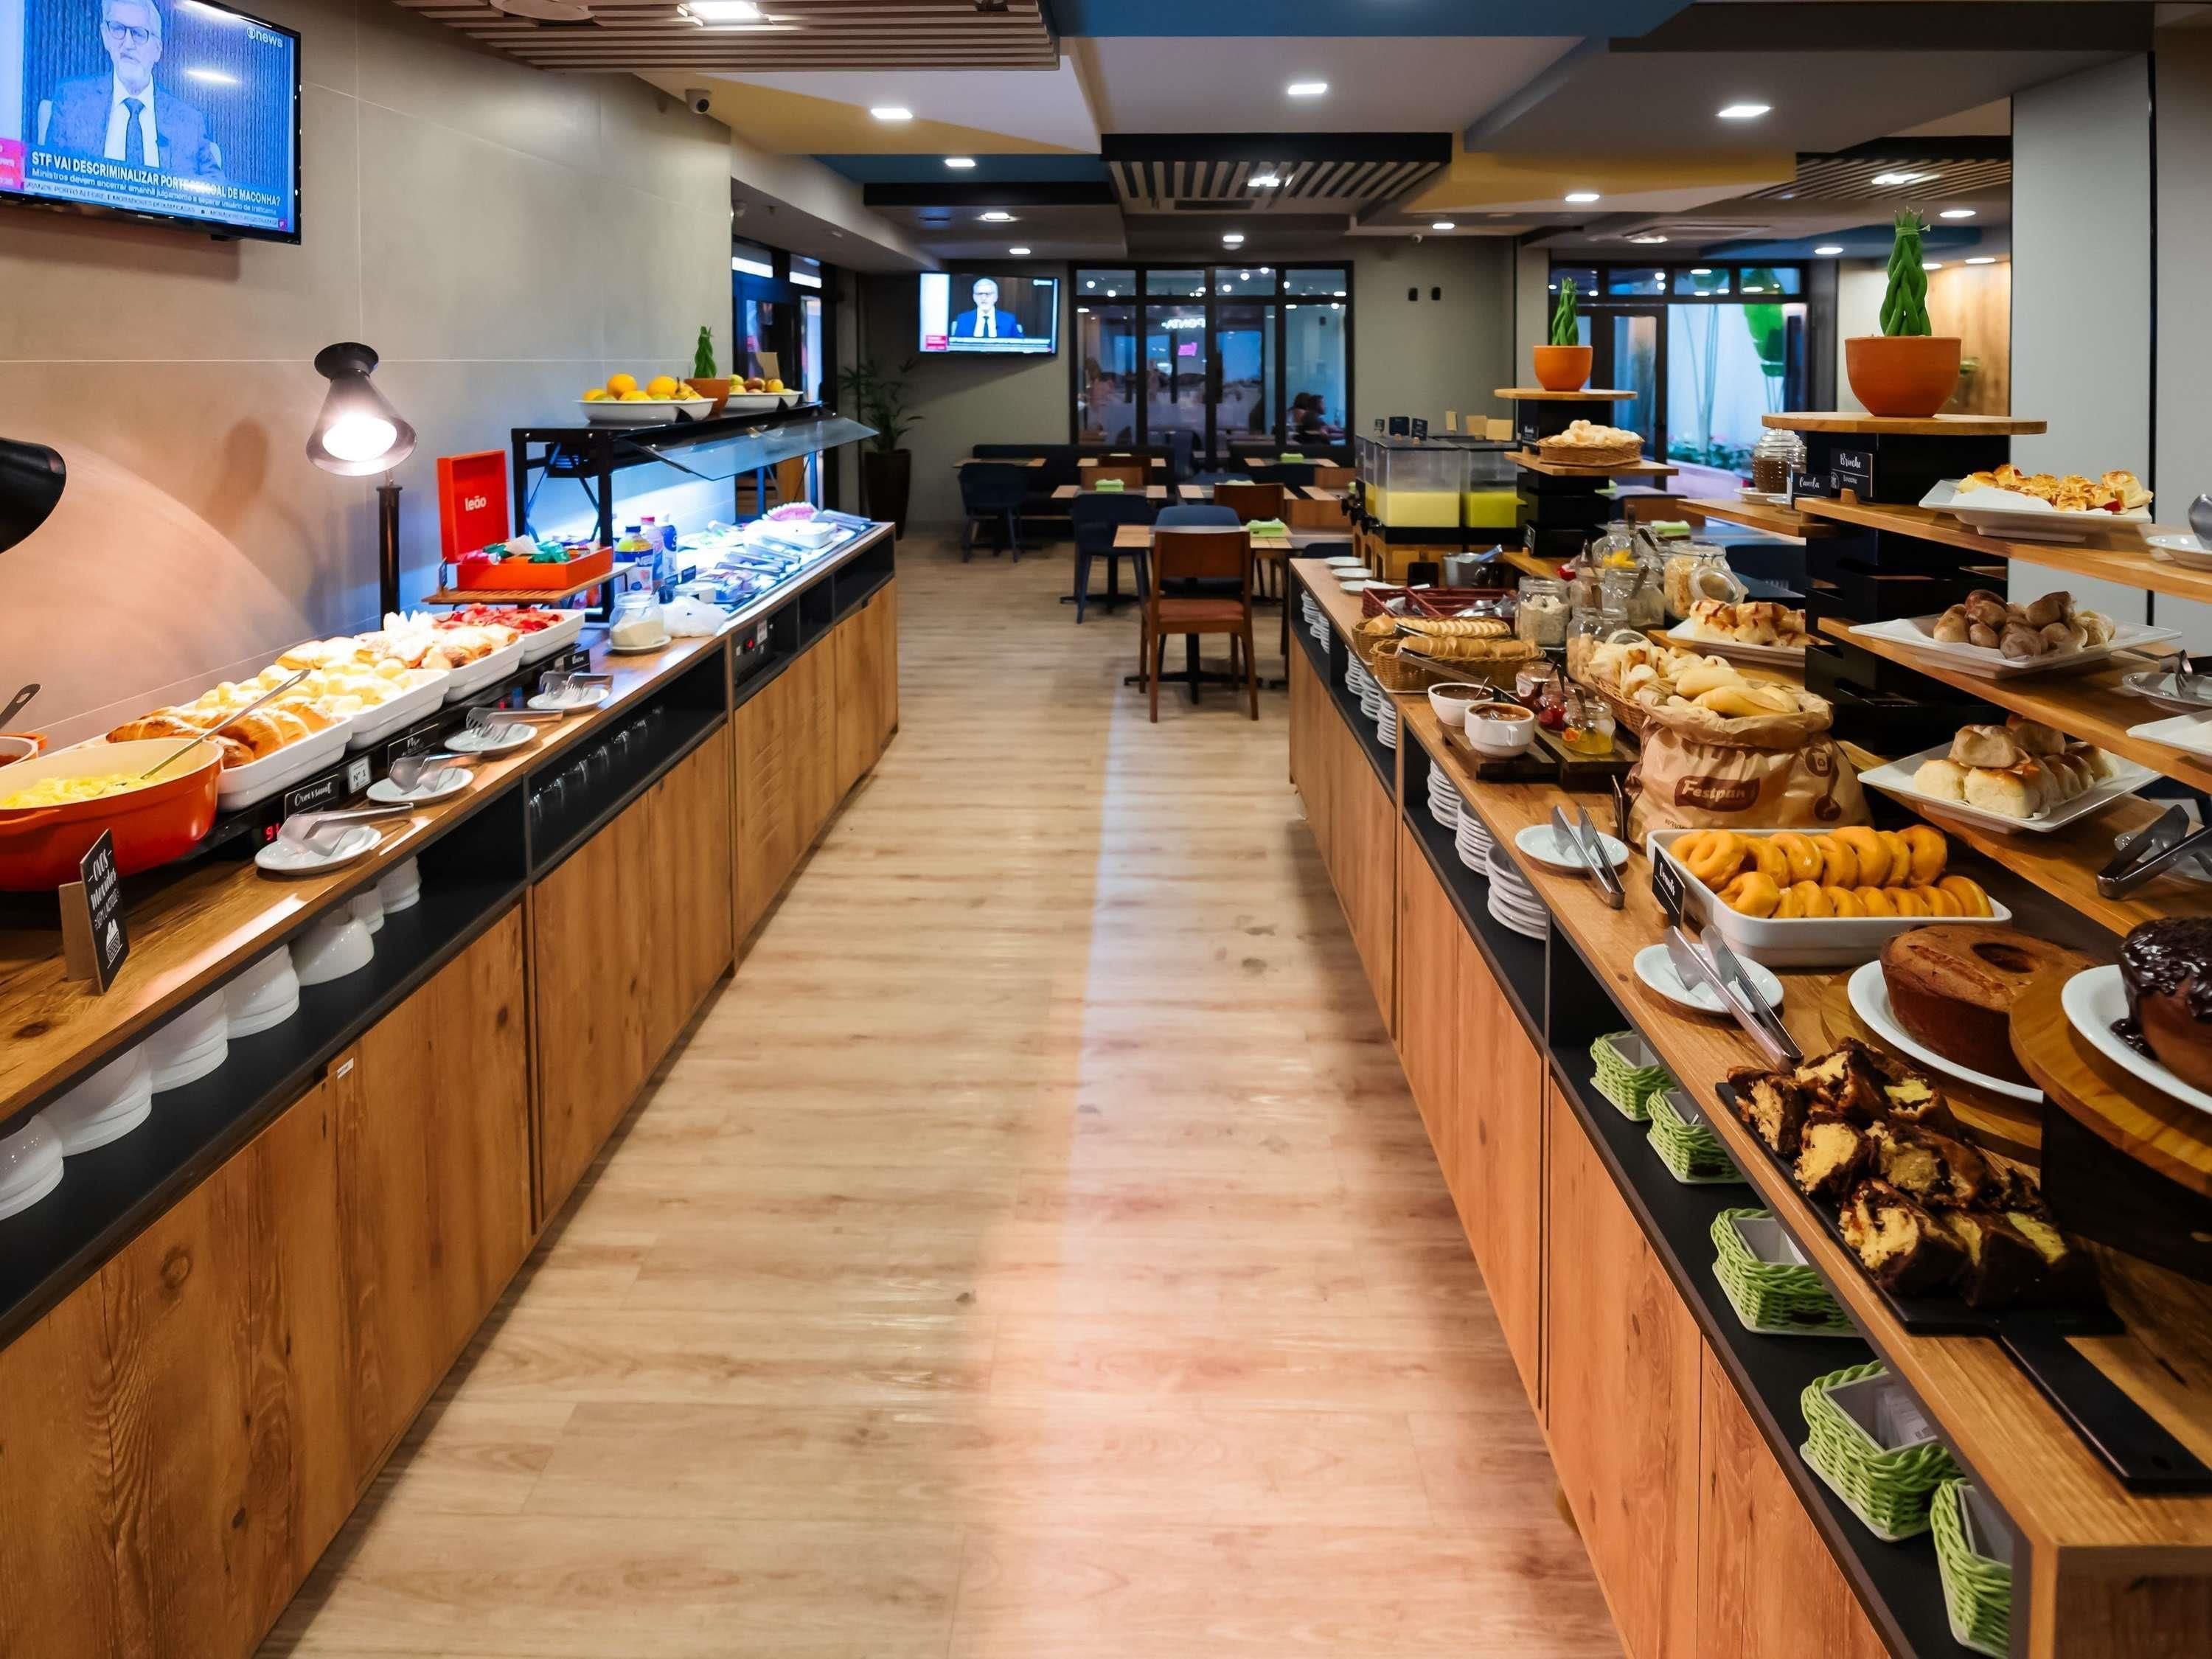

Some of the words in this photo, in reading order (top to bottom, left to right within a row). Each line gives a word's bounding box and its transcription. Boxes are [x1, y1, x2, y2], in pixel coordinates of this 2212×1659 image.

[32, 168, 68, 182] Ministros
[70, 174, 95, 186] devem
[32, 150, 52, 167] STF
[54, 154, 71, 171] VAI
[73, 159, 159, 186] DESCRIMINALIZAR
[228, 187, 237, 198] DE
[239, 189, 281, 206] MACONHA?
[465, 495, 487, 512] leão
[1682, 780, 1746, 802] Festpan
